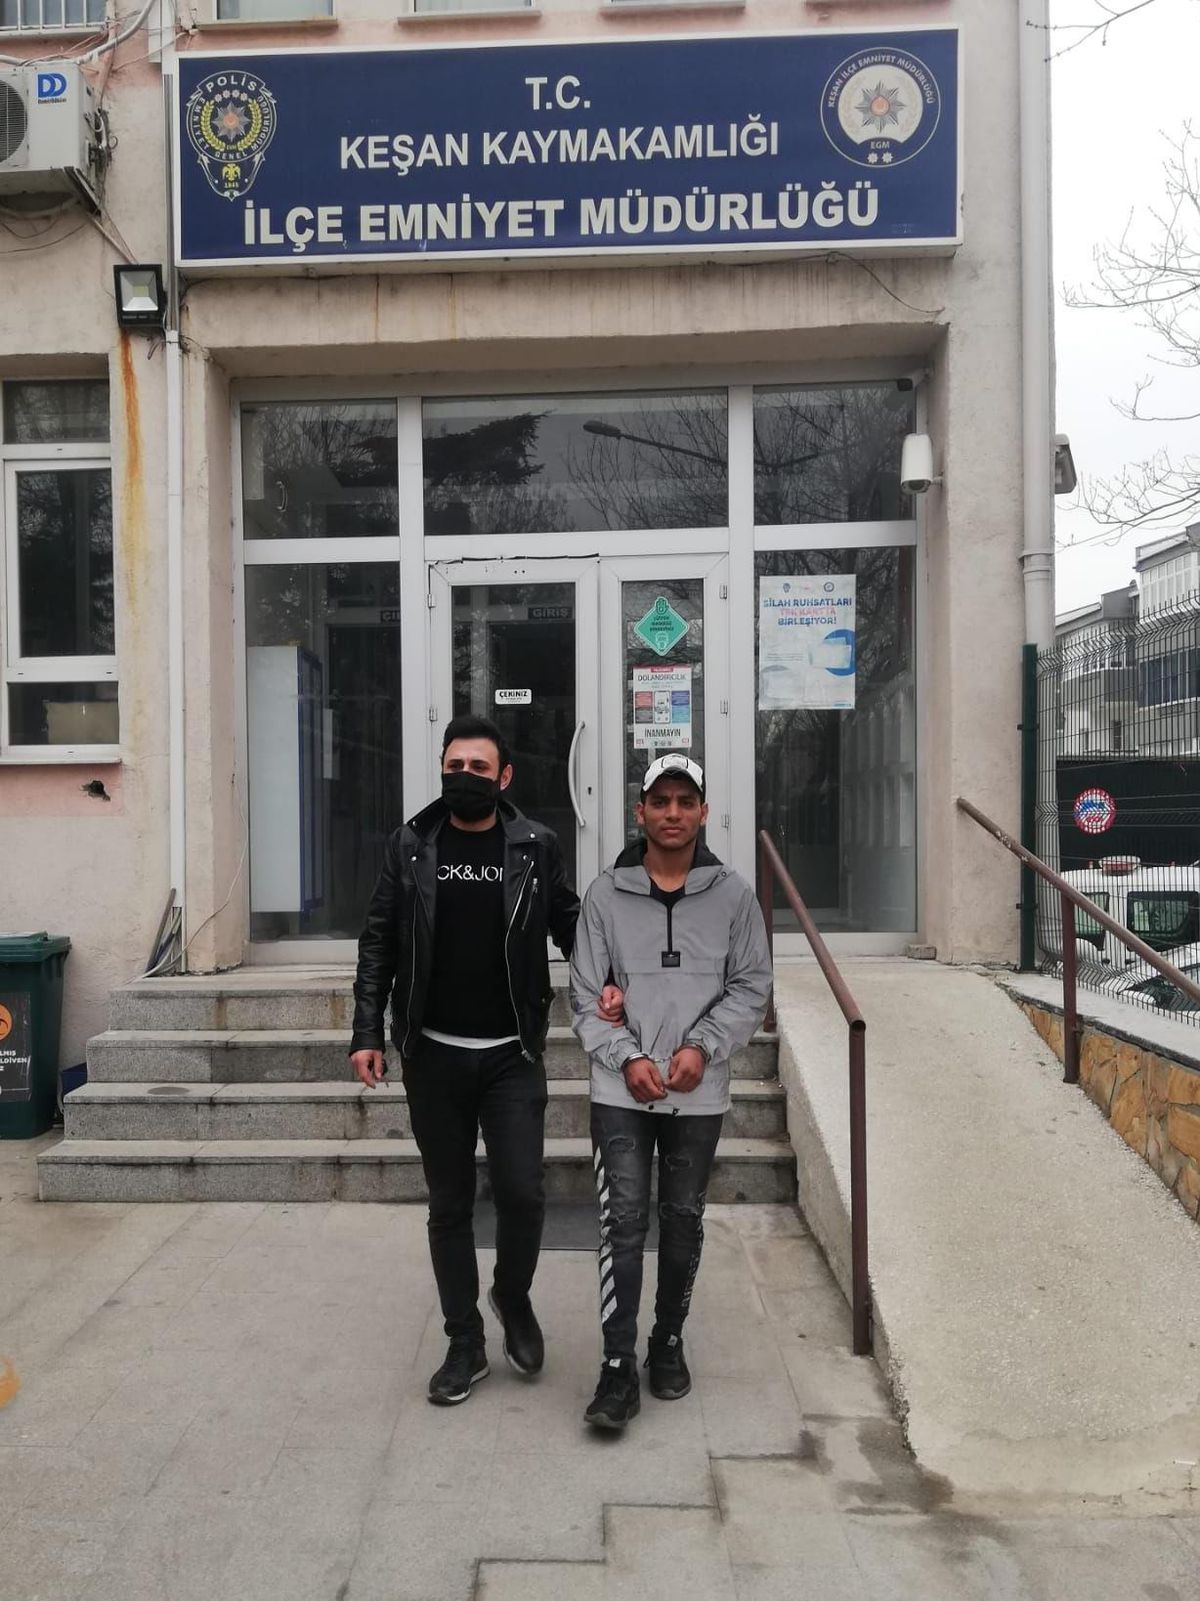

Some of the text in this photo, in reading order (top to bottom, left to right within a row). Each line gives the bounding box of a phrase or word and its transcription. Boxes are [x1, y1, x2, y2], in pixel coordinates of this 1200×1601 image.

[205, 74, 257, 93] POLİS
[525, 75, 591, 110] T.C.
[340, 112, 779, 176] KEŞAN KAYMAKAMLIĞI
[870, 141, 890, 150] EGM
[244, 180, 879, 253] İLÇE EMNİYET MÜDÜRLÜĞÜ
